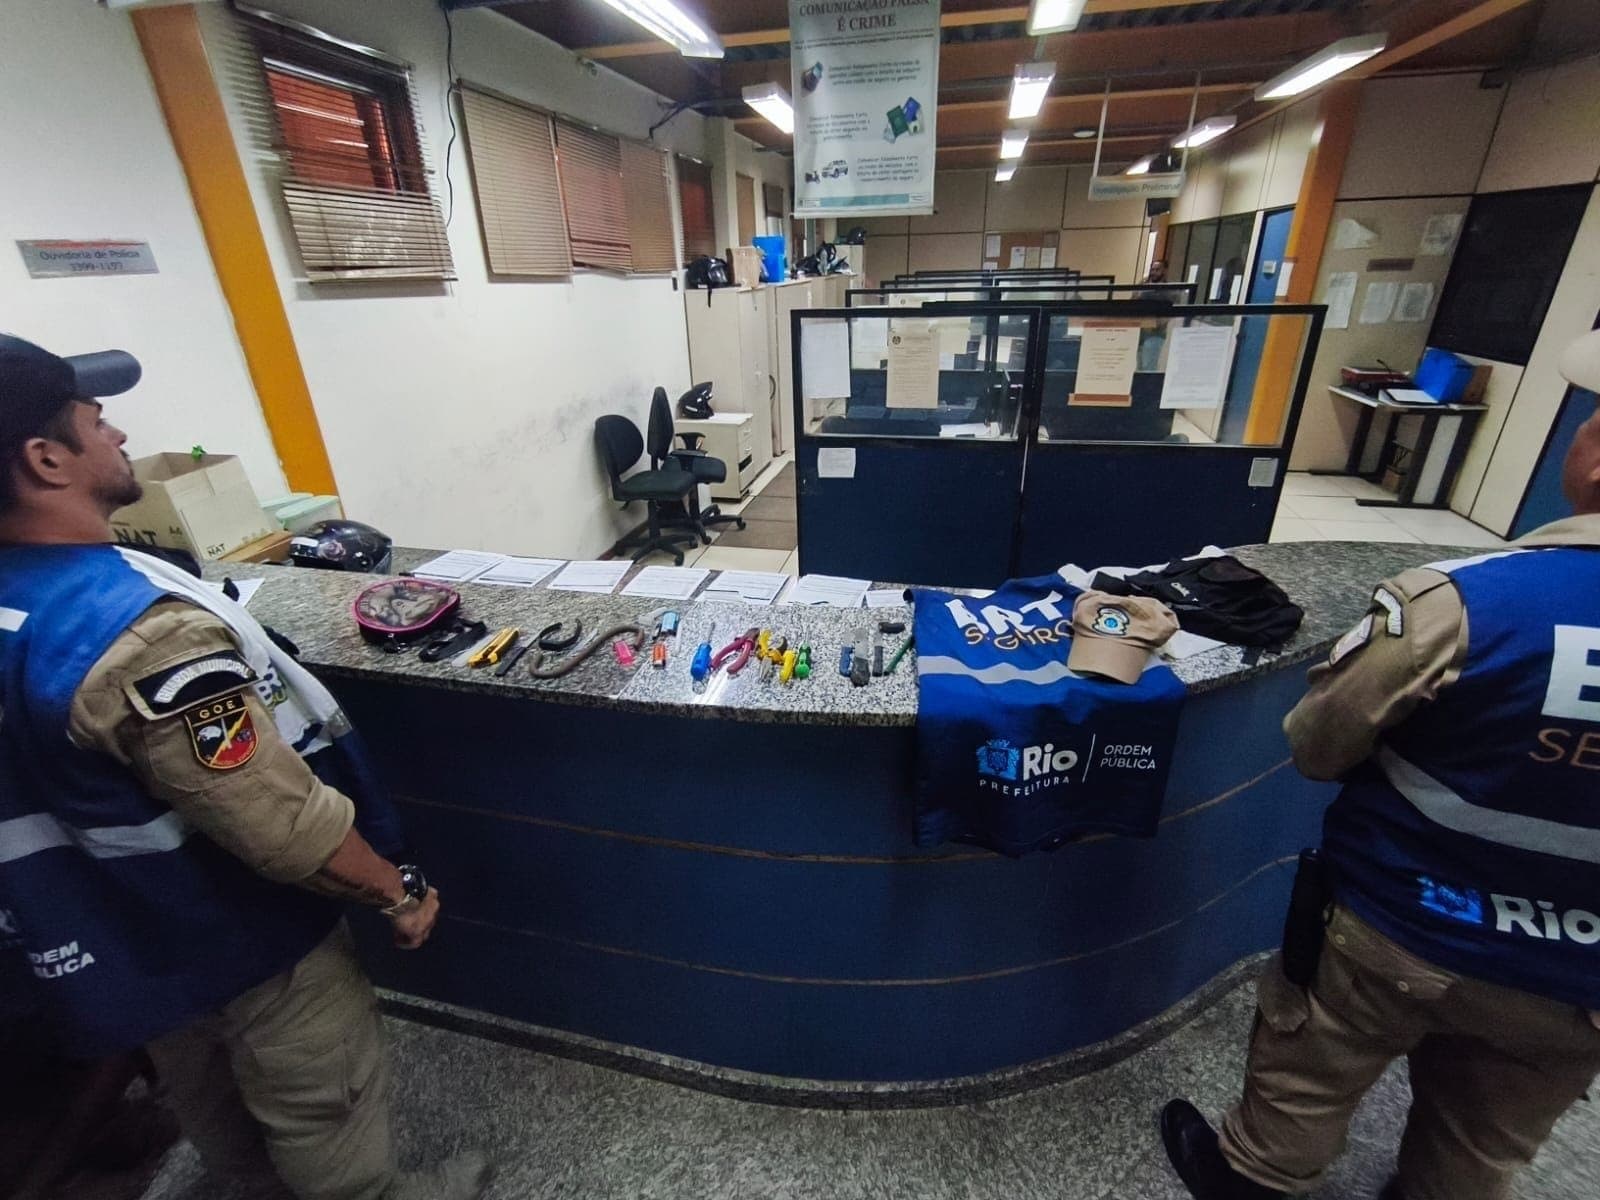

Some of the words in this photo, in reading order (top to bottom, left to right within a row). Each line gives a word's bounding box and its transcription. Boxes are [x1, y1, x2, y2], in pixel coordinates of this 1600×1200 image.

[837, 15, 846, 32] É
[849, 15, 897, 30] CRIME
[40, 250, 92, 260] Ouvidoria
[94, 250, 107, 259] de
[113, 527, 157, 546] NAT
[208, 543, 226, 557] NAT
[154, 663, 199, 703] GUARDA
[200, 658, 249, 679] MUNICIPAL
[200, 701, 236, 719] GOE
[1104, 744, 1152, 756] ORDEM
[1023, 743, 1078, 781] Rio
[1100, 755, 1156, 770] PÚBLICA
[979, 776, 1070, 797] PREFEITURA
[1490, 893, 1600, 945] Rio
